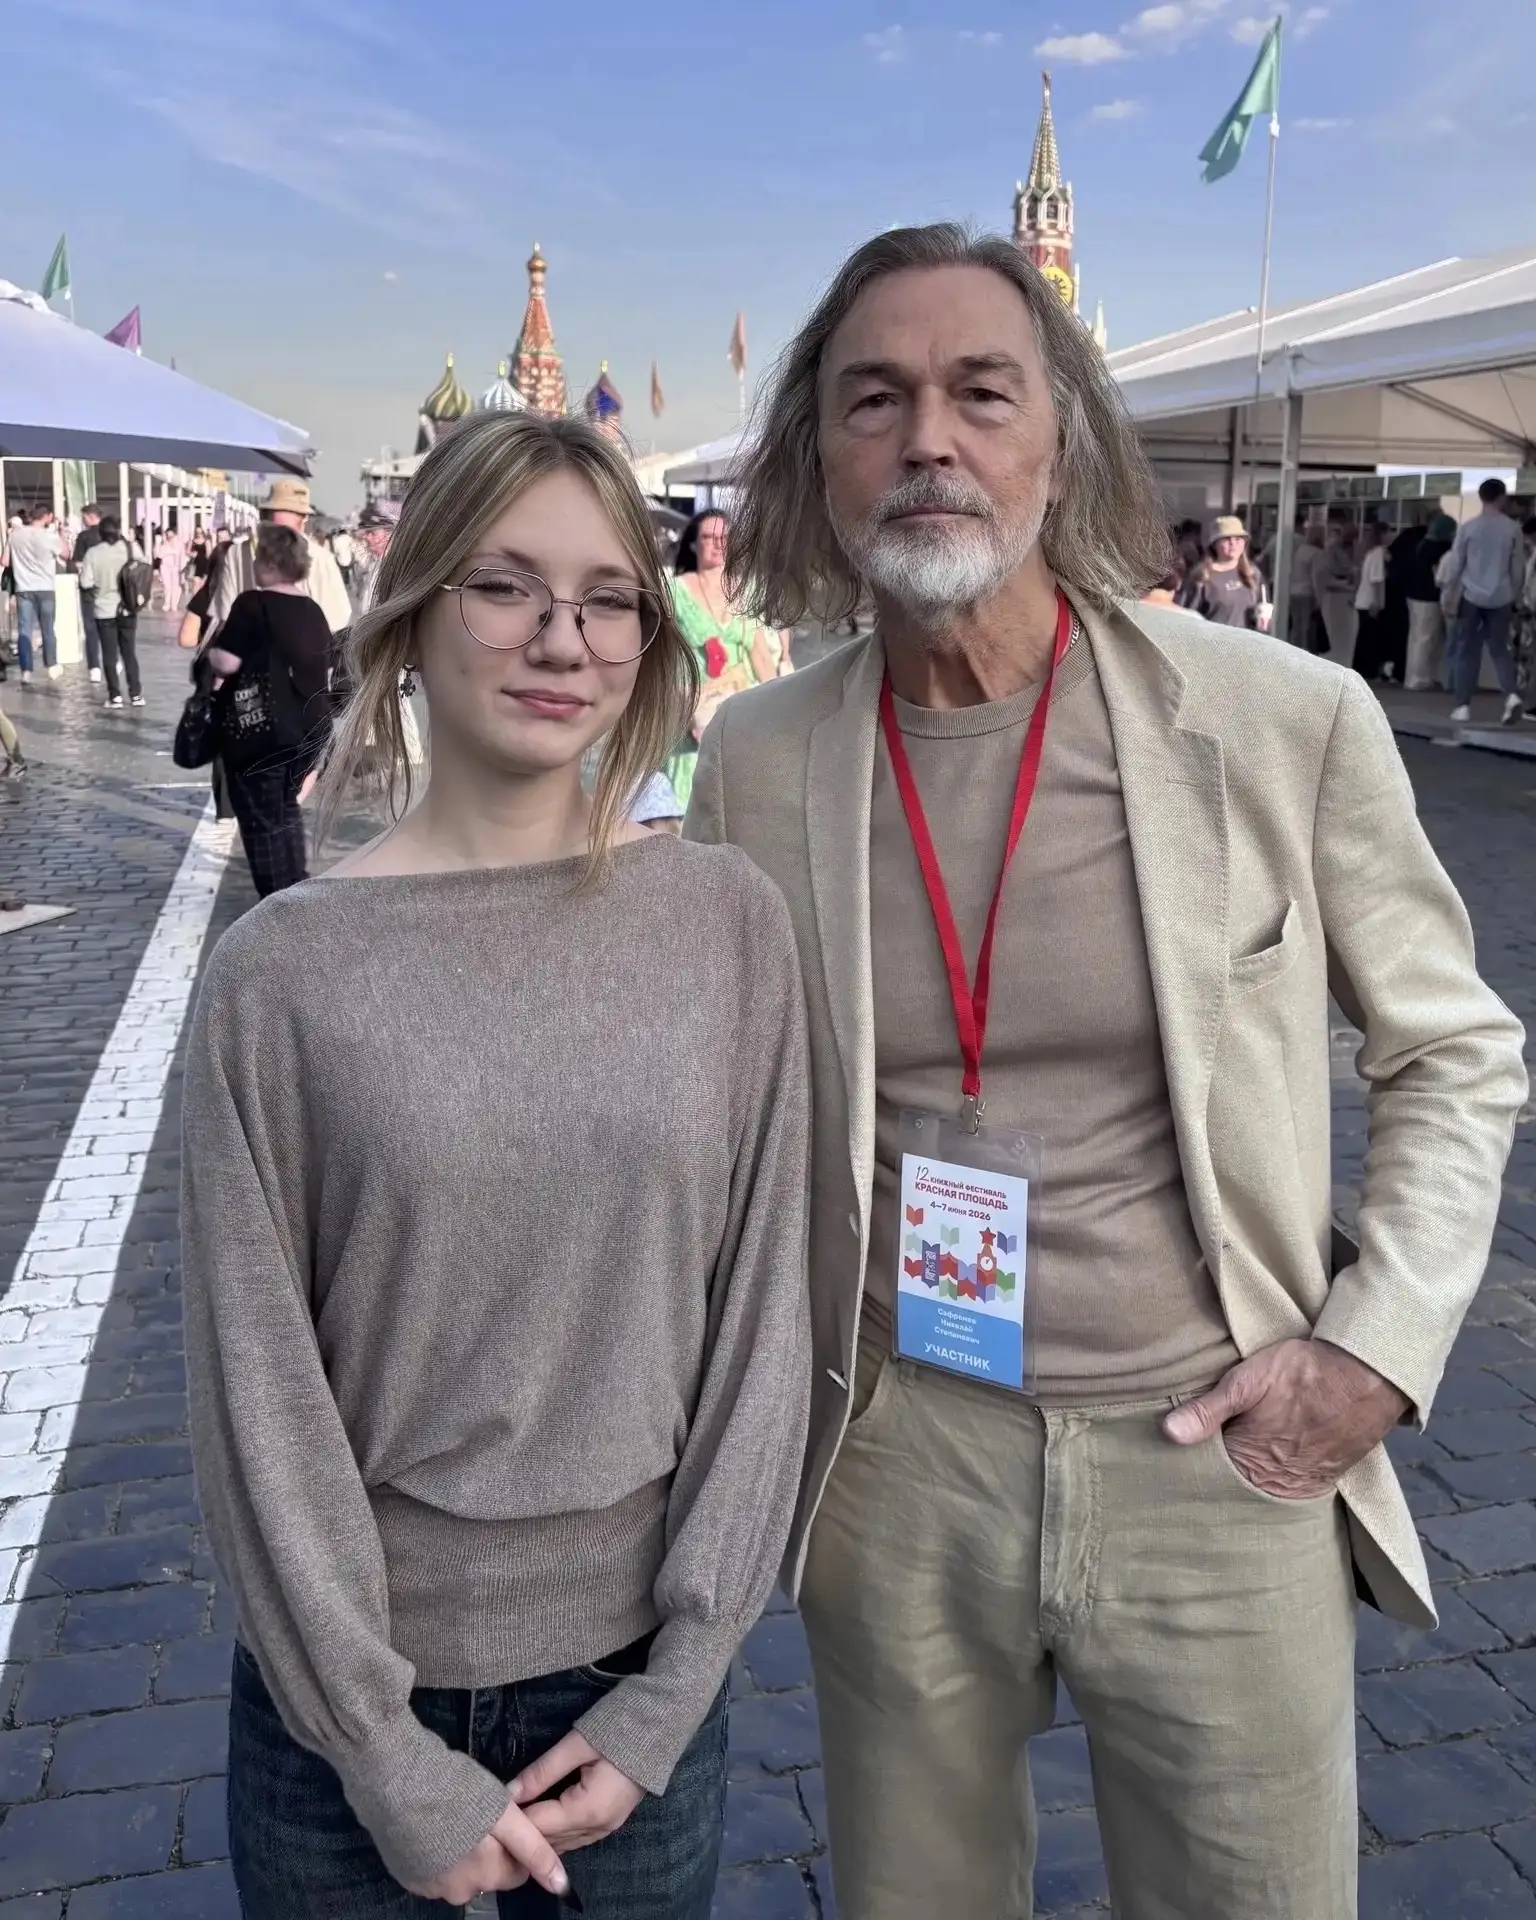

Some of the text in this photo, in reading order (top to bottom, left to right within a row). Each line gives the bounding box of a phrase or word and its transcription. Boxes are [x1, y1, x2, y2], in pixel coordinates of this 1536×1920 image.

[915, 1165, 1007, 1199] 12 КНИЖНЫЙ ФЕСТИВАЛЬ
[915, 1182, 1009, 1211] КРАСНАЯ ПЛОЩАДЬ
[968, 1209, 991, 1221] 2026
[934, 1326, 980, 1345] Степанович
[941, 1318, 973, 1333] Николай
[924, 1342, 992, 1371] УЧАСТНИК
